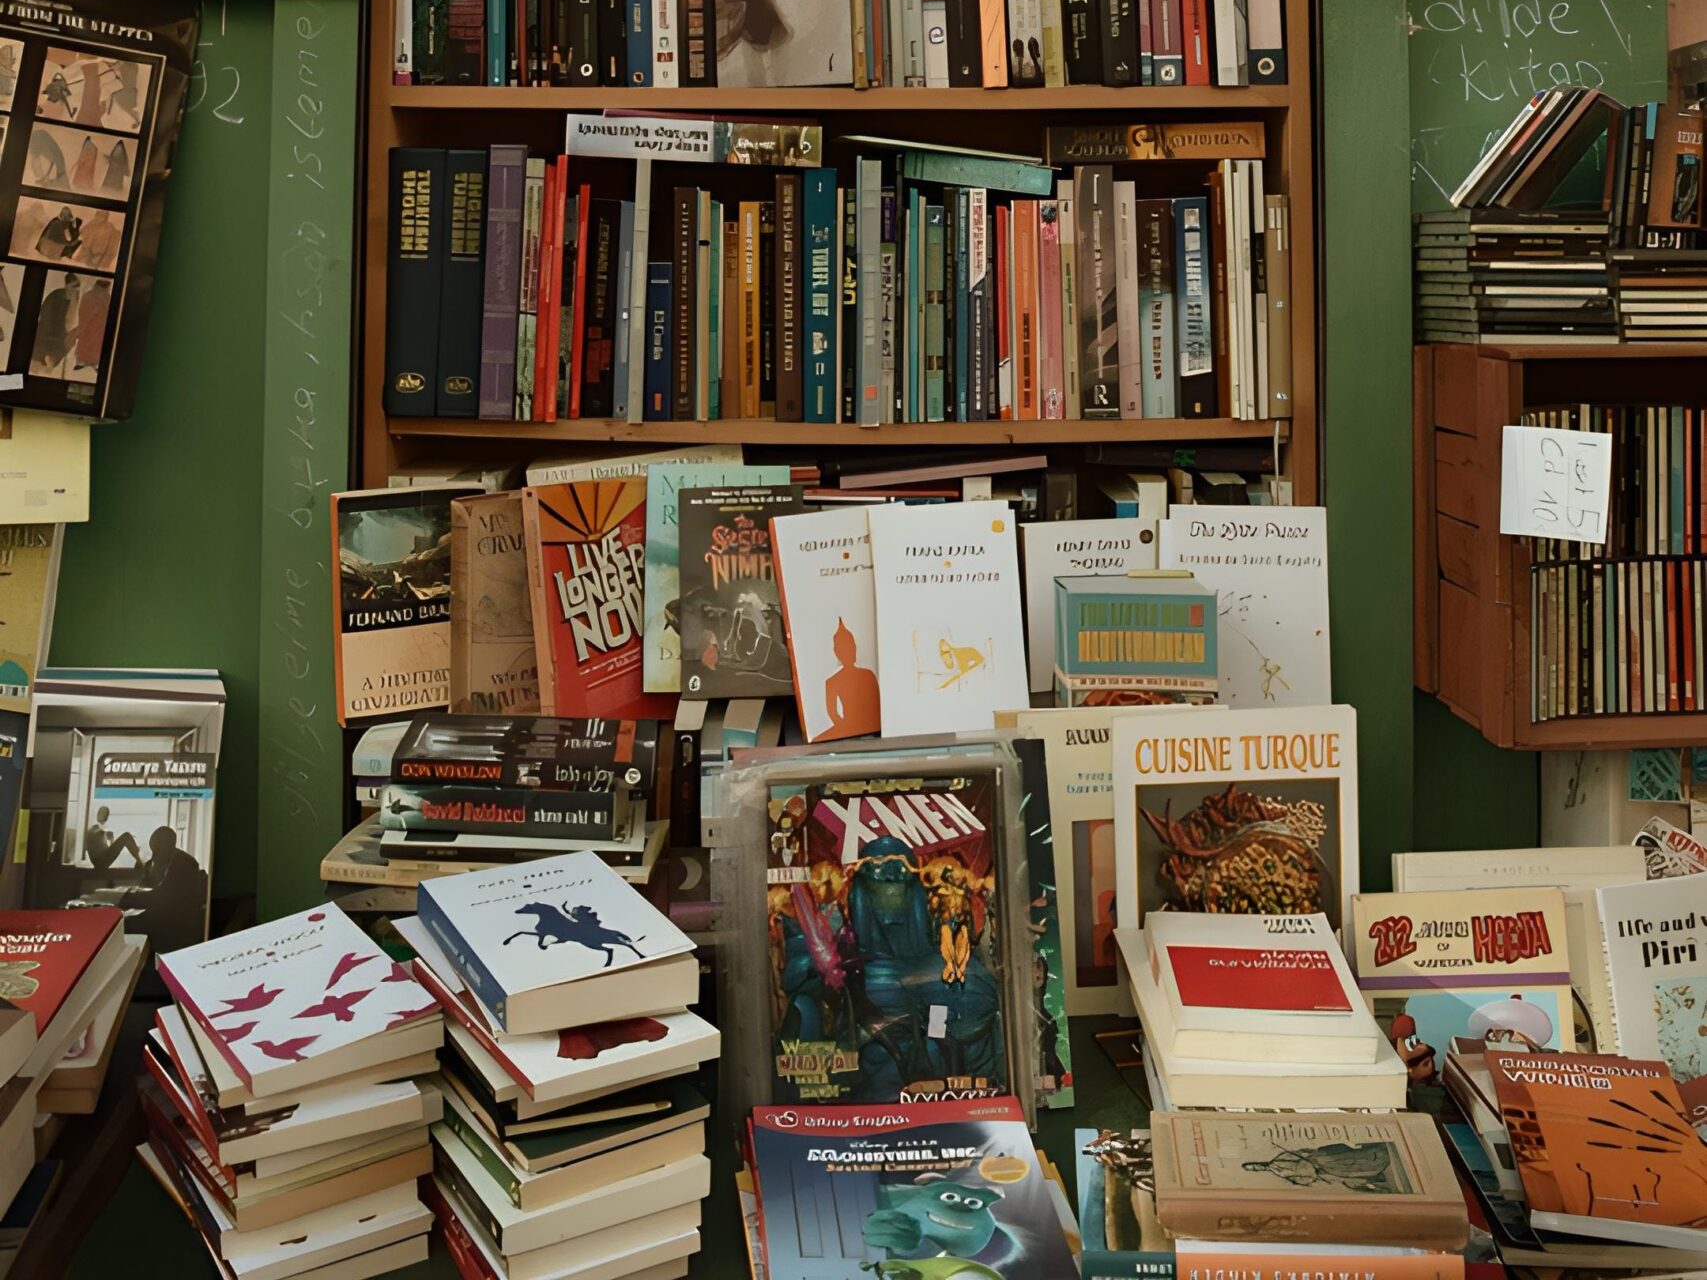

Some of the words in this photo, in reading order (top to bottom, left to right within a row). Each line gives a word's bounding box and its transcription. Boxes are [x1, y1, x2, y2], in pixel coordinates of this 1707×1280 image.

[566, 526, 625, 577] LIVE
[553, 543, 645, 619] LONGER
[1134, 735, 1232, 775] CUISINE
[1239, 733, 1341, 772] TURQUE
[820, 793, 987, 865] X-MEN
[1642, 937, 1698, 969] Piri
